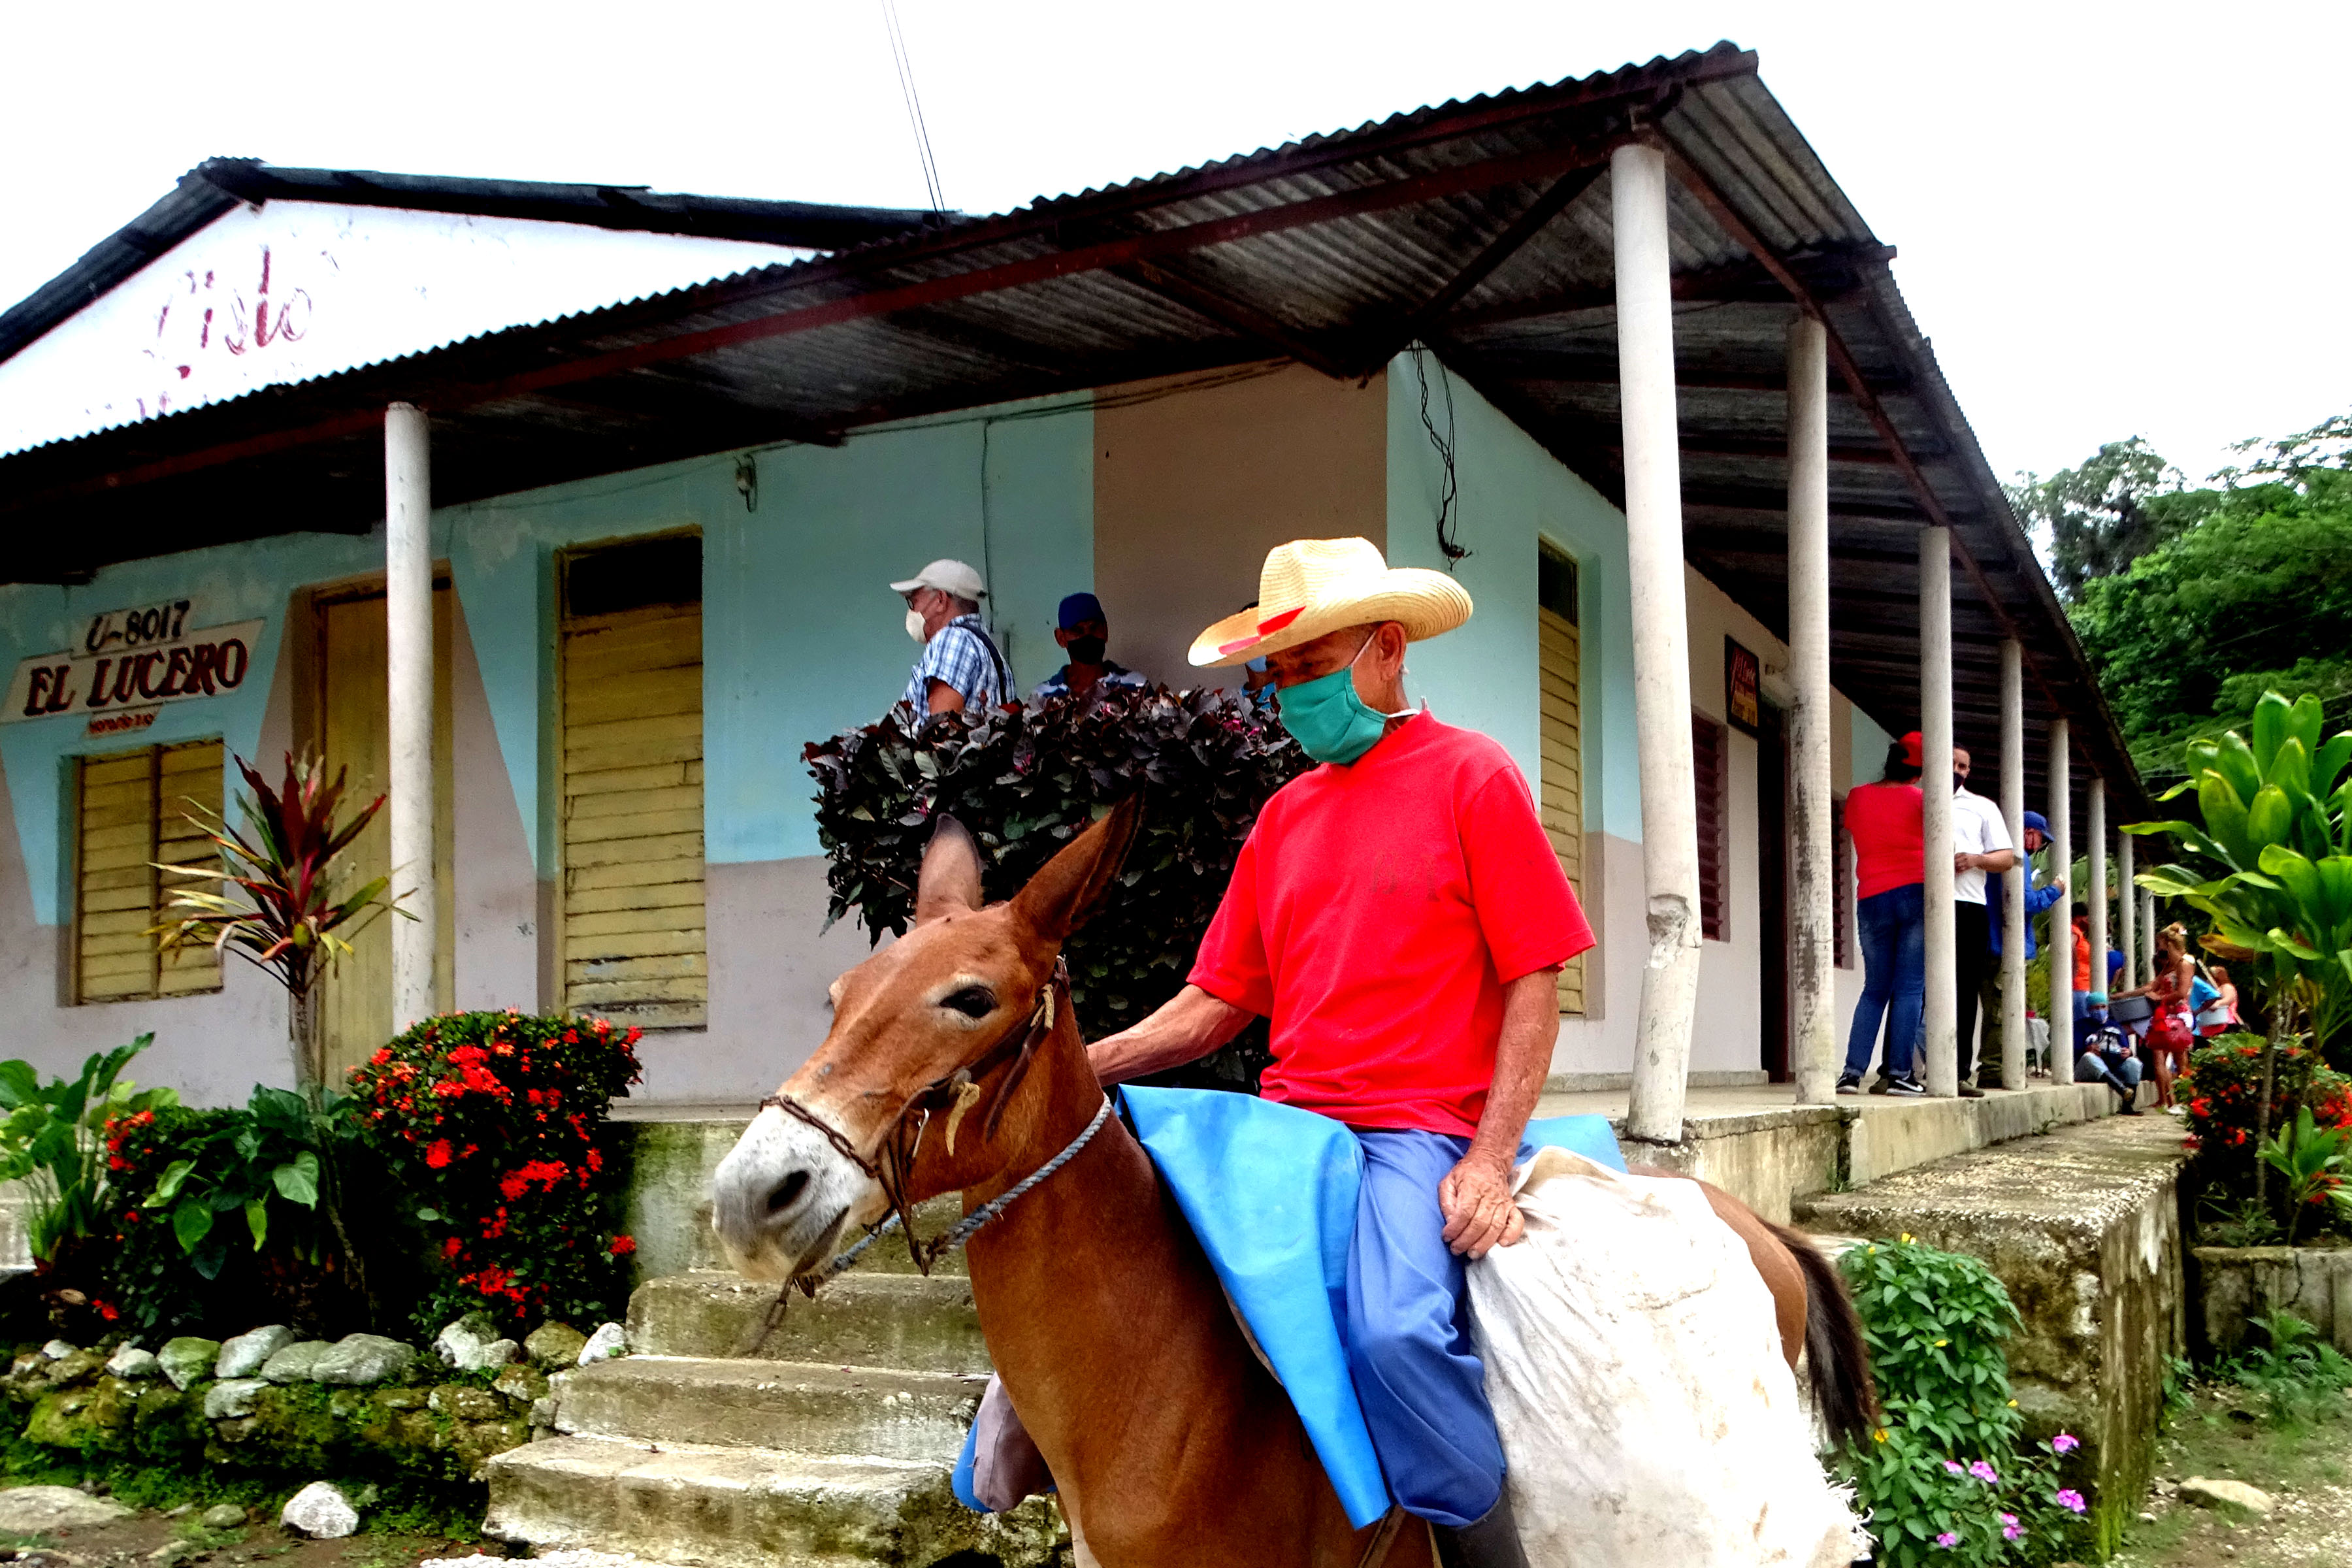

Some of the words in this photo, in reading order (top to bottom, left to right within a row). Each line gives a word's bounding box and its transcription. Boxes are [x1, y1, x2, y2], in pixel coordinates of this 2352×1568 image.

[86, 600, 190, 651] U-8017
[24, 664, 76, 717] EL
[86, 638, 248, 708] LUCERO
